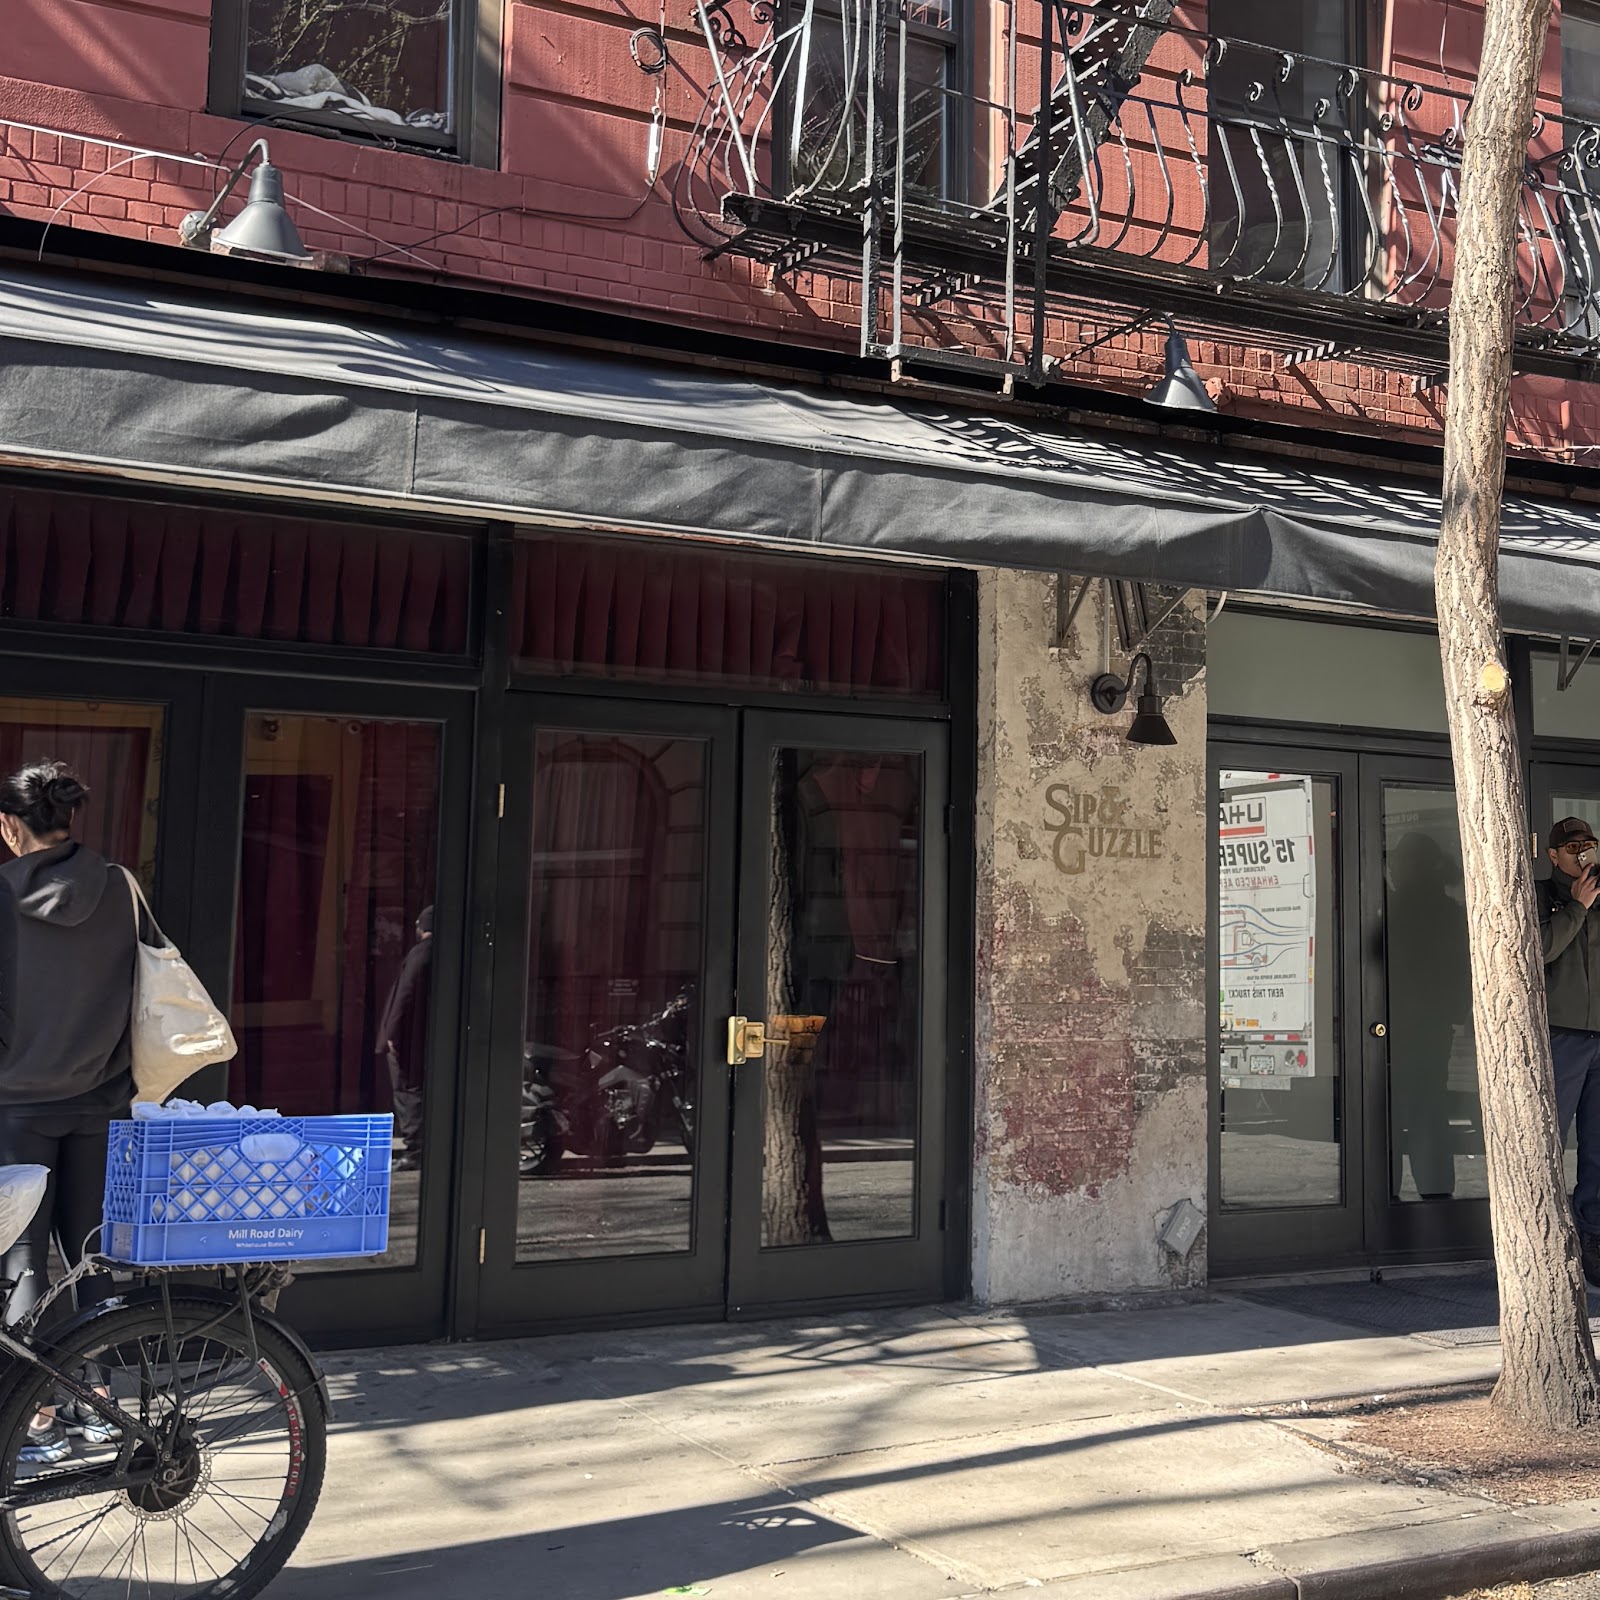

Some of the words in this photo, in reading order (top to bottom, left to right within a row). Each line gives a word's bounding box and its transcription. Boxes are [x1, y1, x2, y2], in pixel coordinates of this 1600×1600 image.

[1044, 783, 1097, 832] SIP
[1053, 827, 1162, 875] GUZZLE
[228, 1229, 248, 1240] Mill
[250, 1228, 276, 1239] Road
[277, 1227, 304, 1239] Dairy
